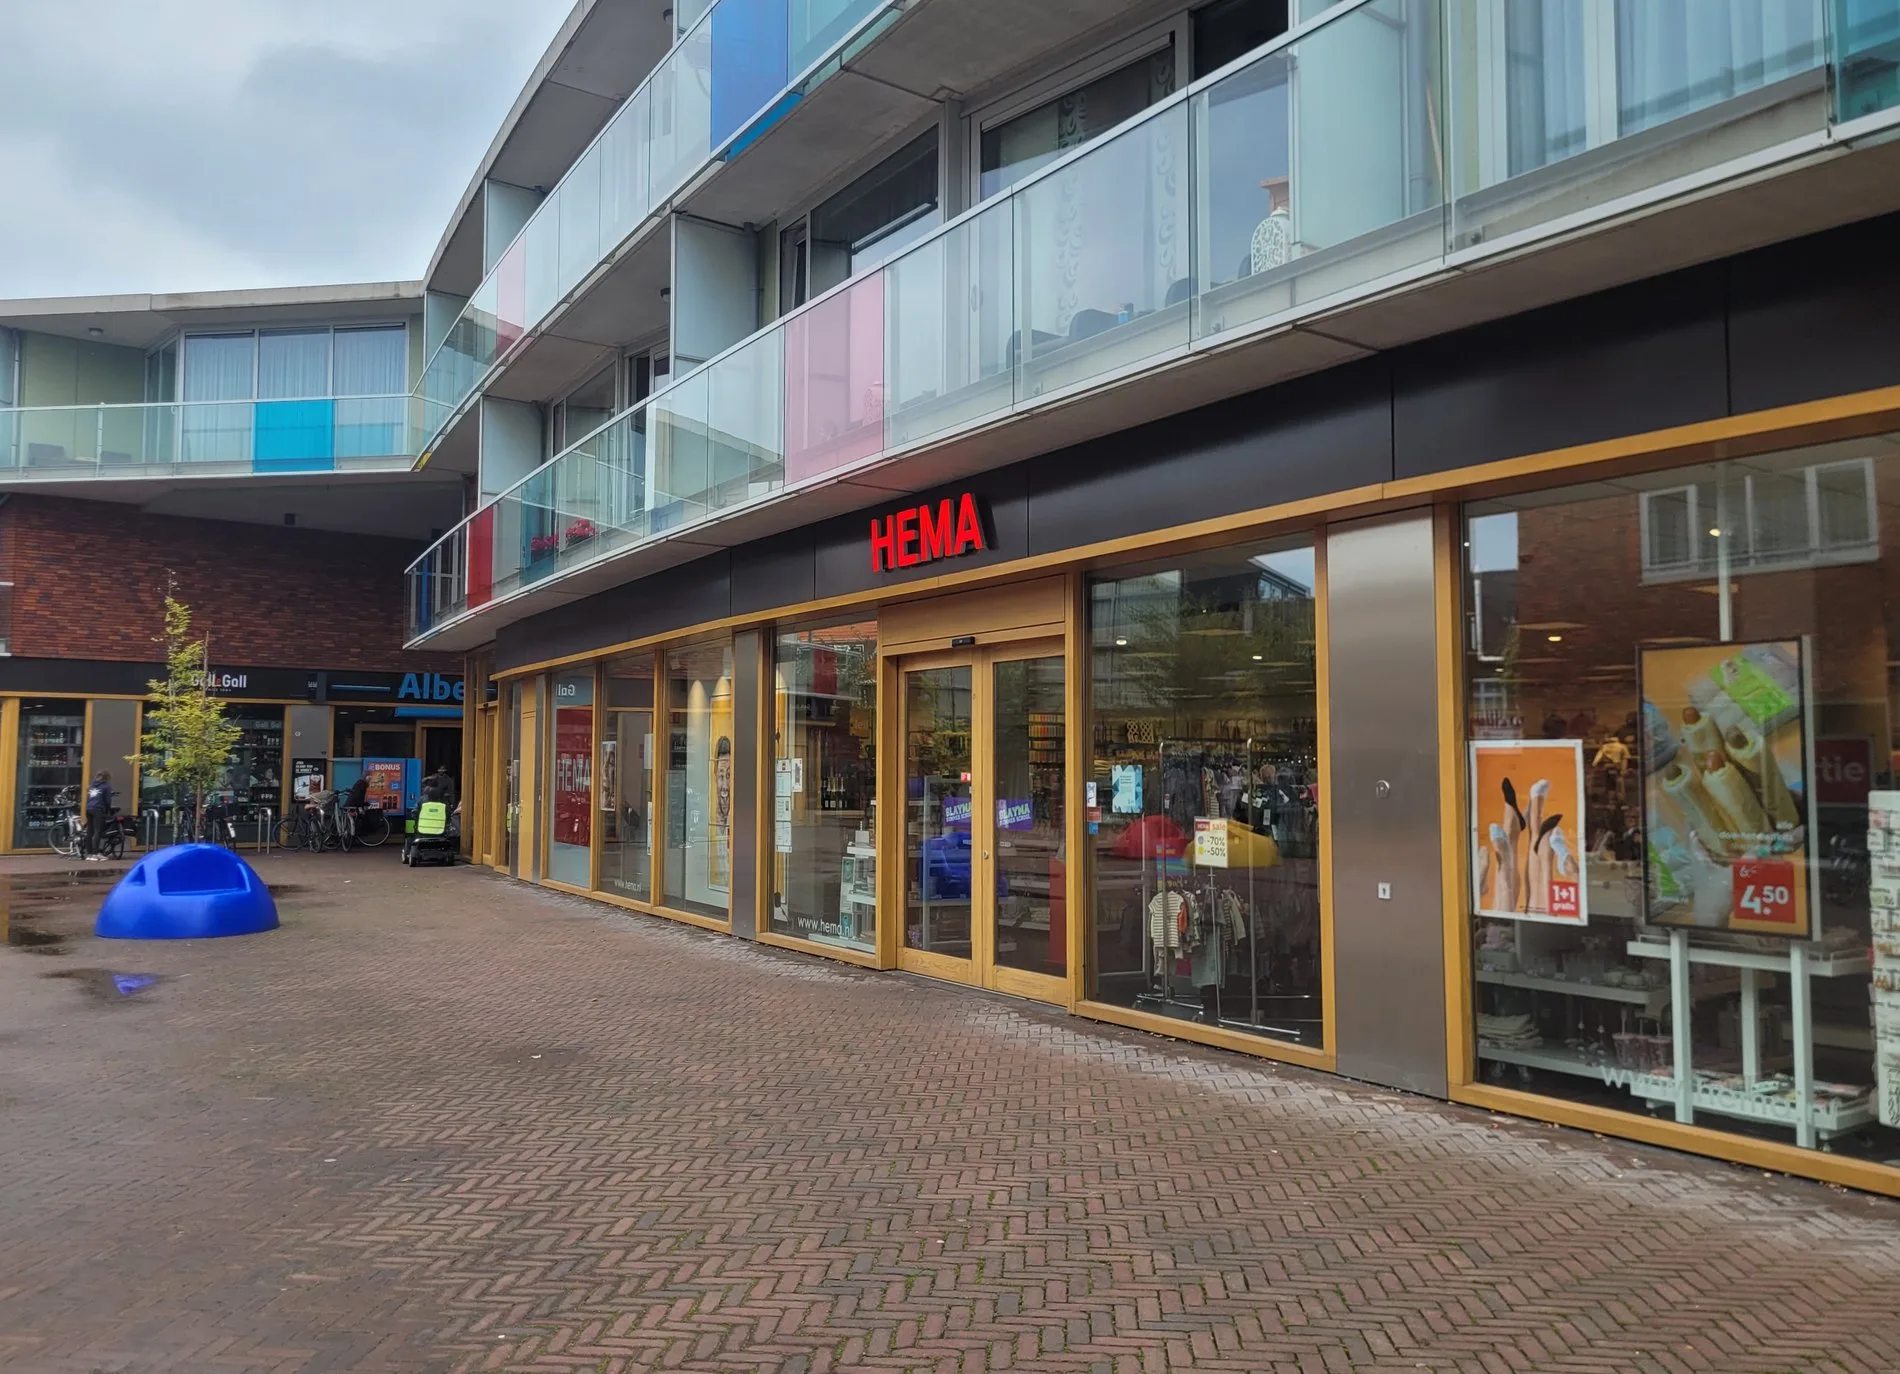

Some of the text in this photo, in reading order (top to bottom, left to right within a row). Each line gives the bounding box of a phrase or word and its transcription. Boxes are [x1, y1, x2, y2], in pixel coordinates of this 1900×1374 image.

[871, 493, 983, 573] HEMA
[222, 674, 247, 688] Gall
[375, 763, 401, 771] BONUS
[556, 759, 592, 792] HEMA
[1211, 823, 1226, 831] sale
[1207, 835, 1226, 847] -70%
[1207, 846, 1226, 857] -50%
[1551, 884, 1577, 906] 1+1
[797, 916, 853, 938] www.hema.nl
